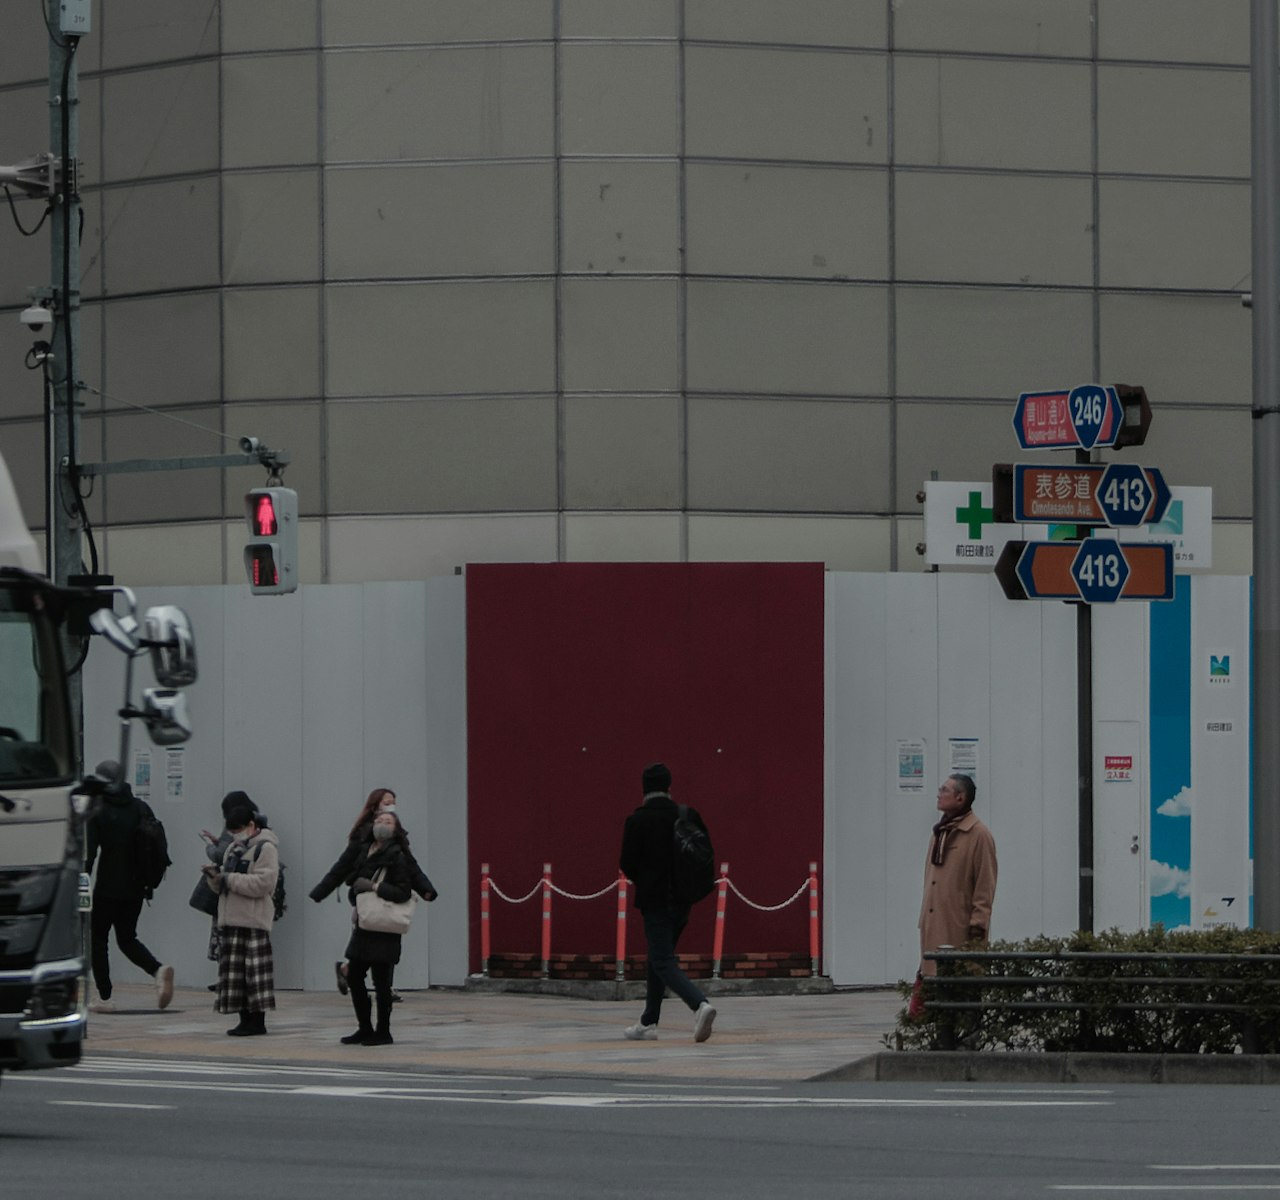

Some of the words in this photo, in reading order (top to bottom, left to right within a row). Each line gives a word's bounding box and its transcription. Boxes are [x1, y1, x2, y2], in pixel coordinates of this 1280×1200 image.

[1026, 400, 1067, 426] 青山通り
[1074, 395, 1102, 426] 246
[1035, 473, 1091, 500] 表参道
[1104, 477, 1145, 512] 413
[1031, 501, 1074, 515] Omotesando
[1077, 502, 1093, 516] Ave.
[1078, 554, 1120, 587] 413
